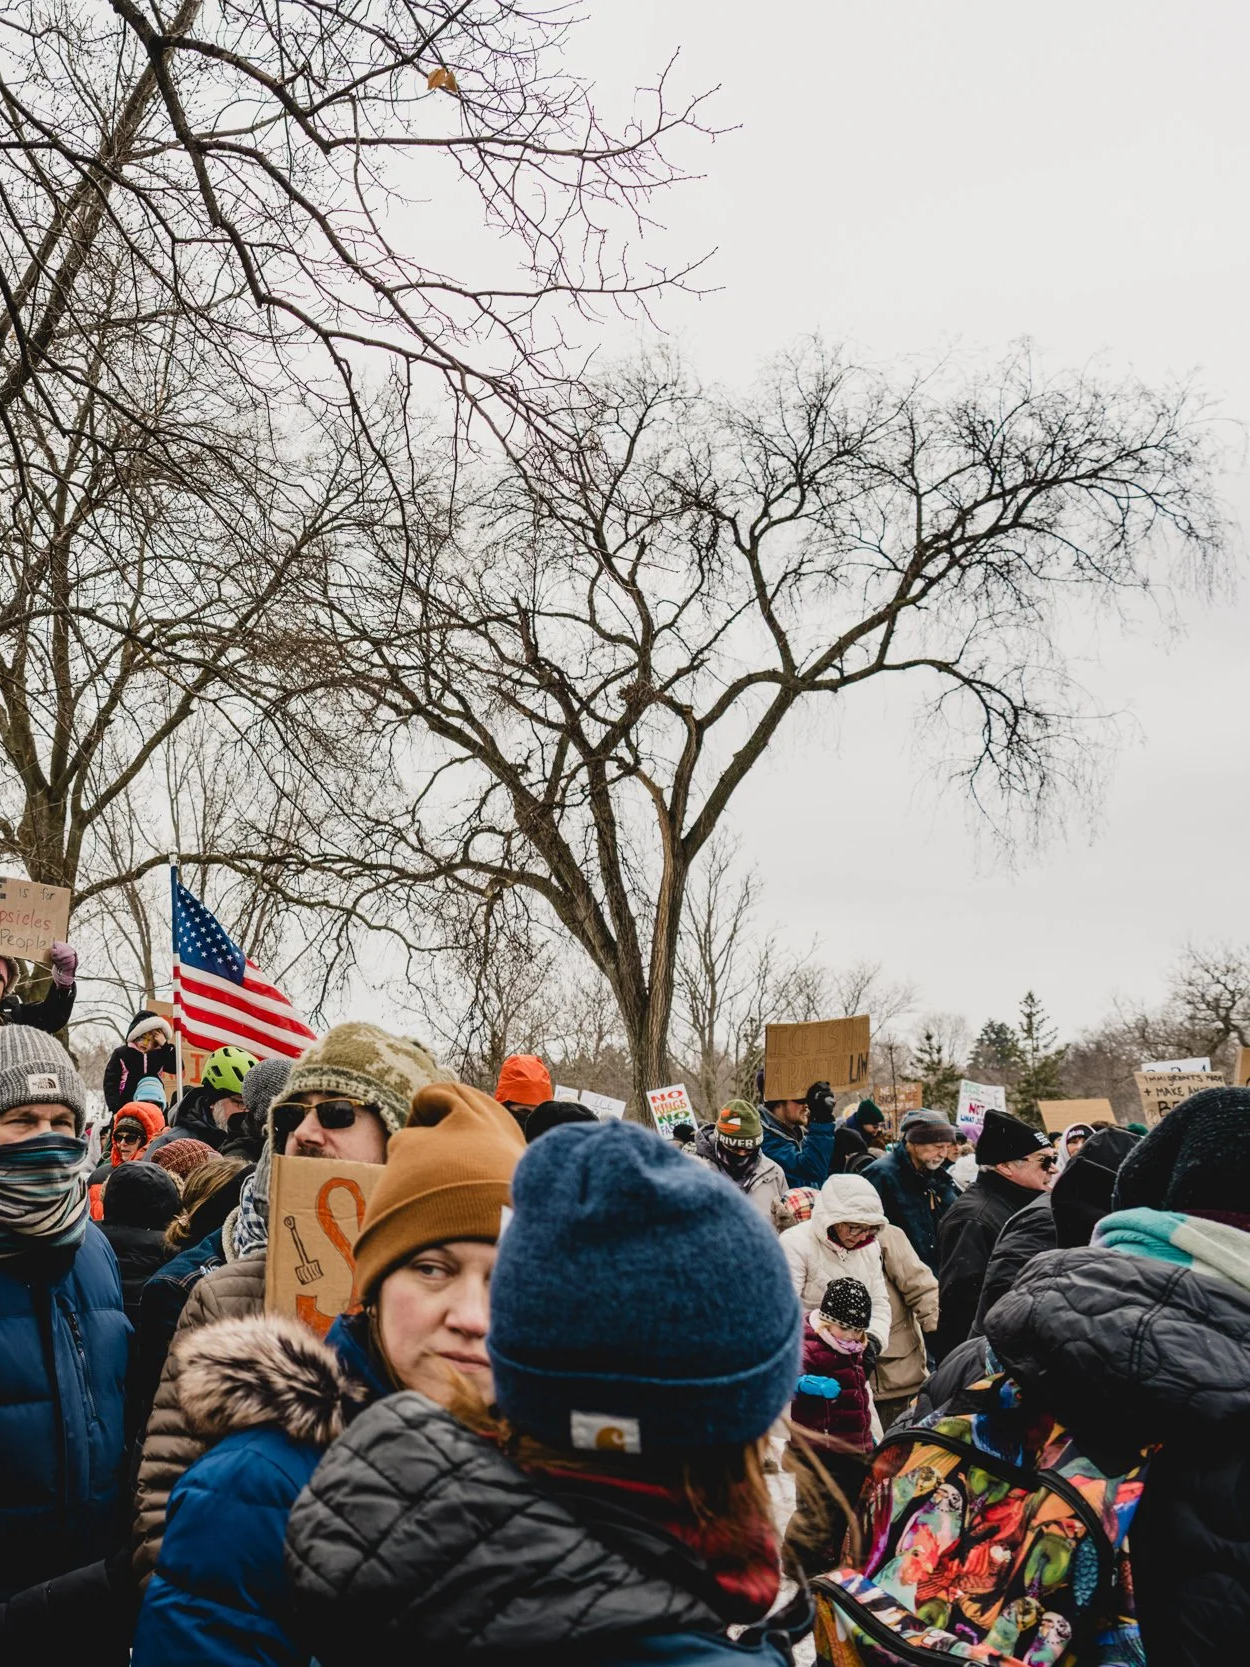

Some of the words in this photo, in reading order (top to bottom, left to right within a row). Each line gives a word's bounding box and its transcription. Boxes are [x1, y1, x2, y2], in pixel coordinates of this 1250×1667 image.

[40, 887, 55, 900] for
[769, 1026, 810, 1057] ICE
[848, 1051, 869, 1084] LAW
[1144, 1074, 1203, 1086] IMMIGRANTS
[651, 1090, 683, 1103] NO
[1155, 1086, 1184, 1097] MAKE
[654, 1098, 687, 1116] KINGS
[968, 1102, 986, 1117] NOT
[657, 1110, 690, 1124] NO
[720, 1134, 754, 1147] RIVER
